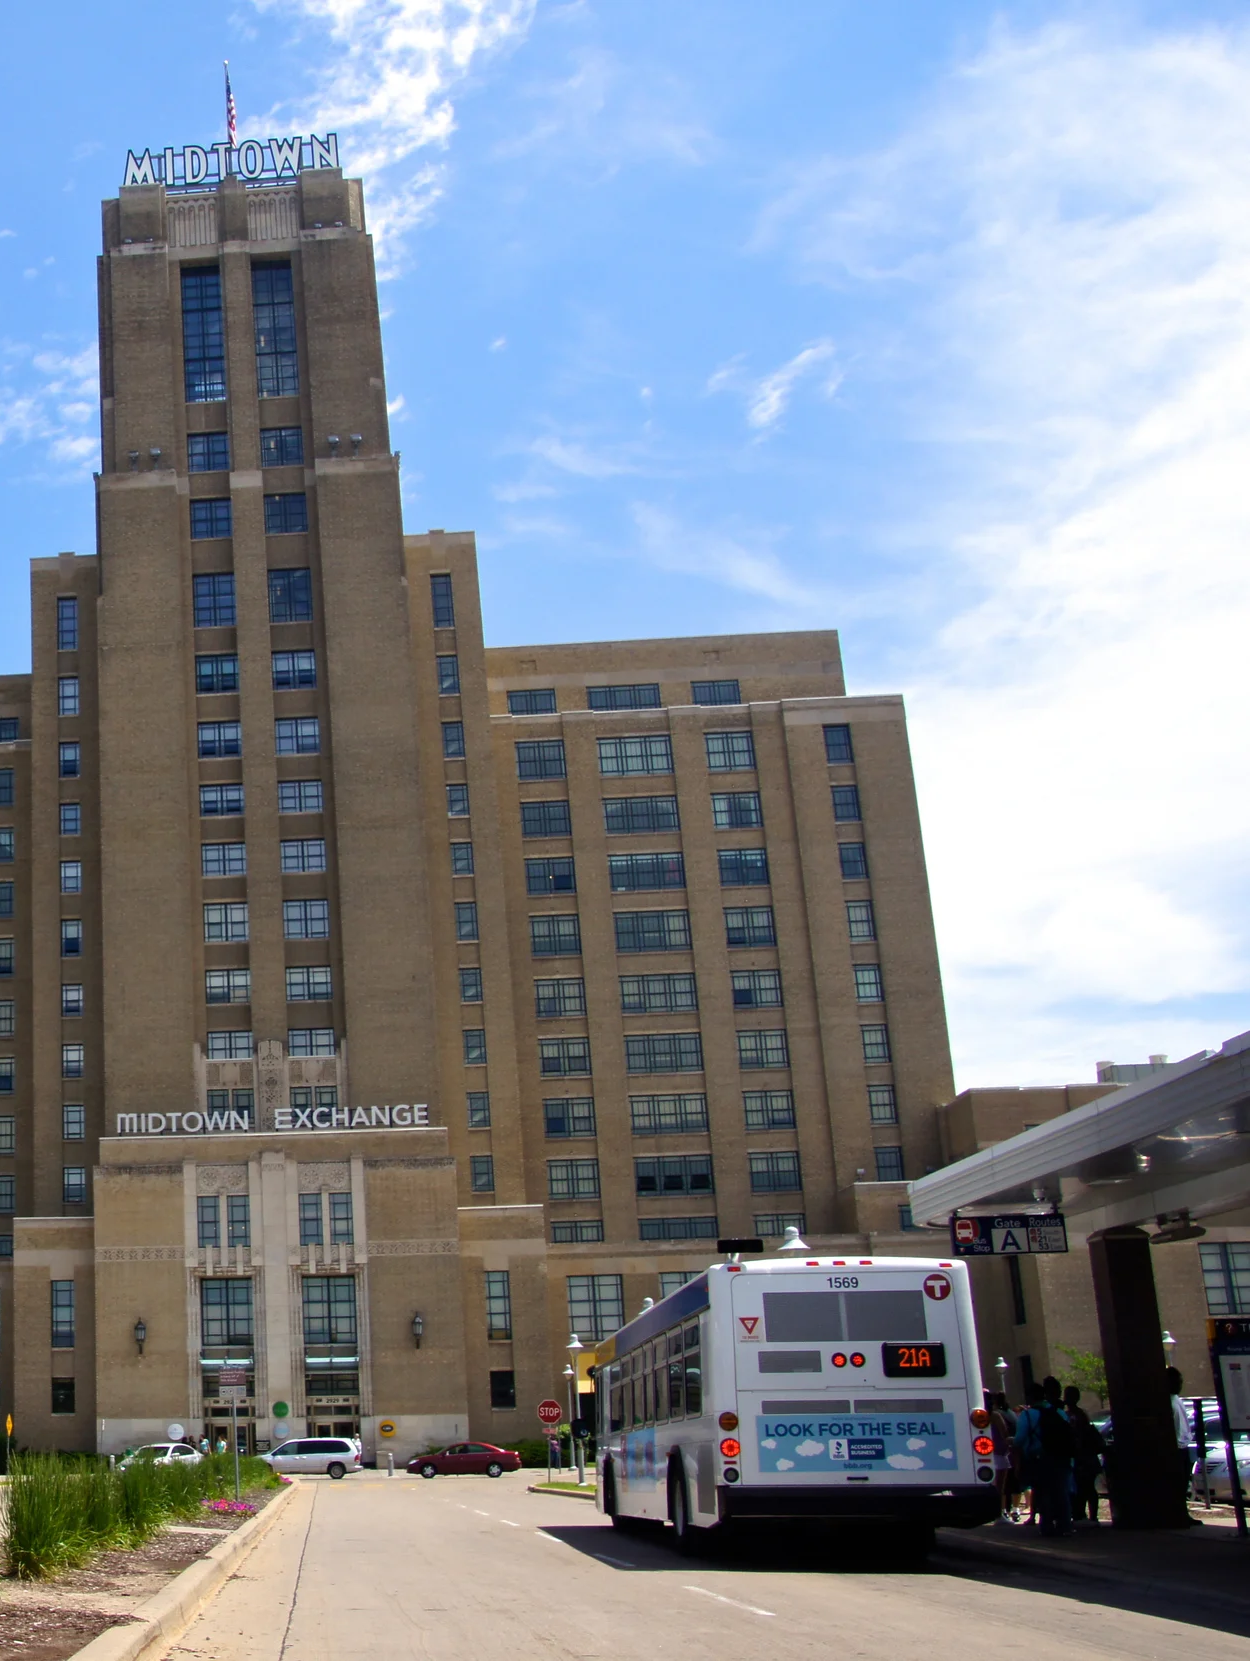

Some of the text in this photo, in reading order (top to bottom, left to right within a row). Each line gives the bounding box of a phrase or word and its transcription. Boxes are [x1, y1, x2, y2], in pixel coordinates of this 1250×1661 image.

[124, 133, 339, 185] MIDTOWN
[116, 1104, 429, 1133] MIDTOWN EXCHANGE
[994, 1217, 1061, 1228] Gate Routes
[1000, 1229, 1022, 1251] A
[1038, 1235, 1047, 1243] 21
[973, 1244, 990, 1252] Stop
[826, 1276, 859, 1289] 1569
[926, 1279, 947, 1298] T
[898, 1348, 931, 1367] 21A
[539, 1406, 560, 1417] STOP
[765, 1422, 947, 1437] LOOK FOR THE SEAL.
